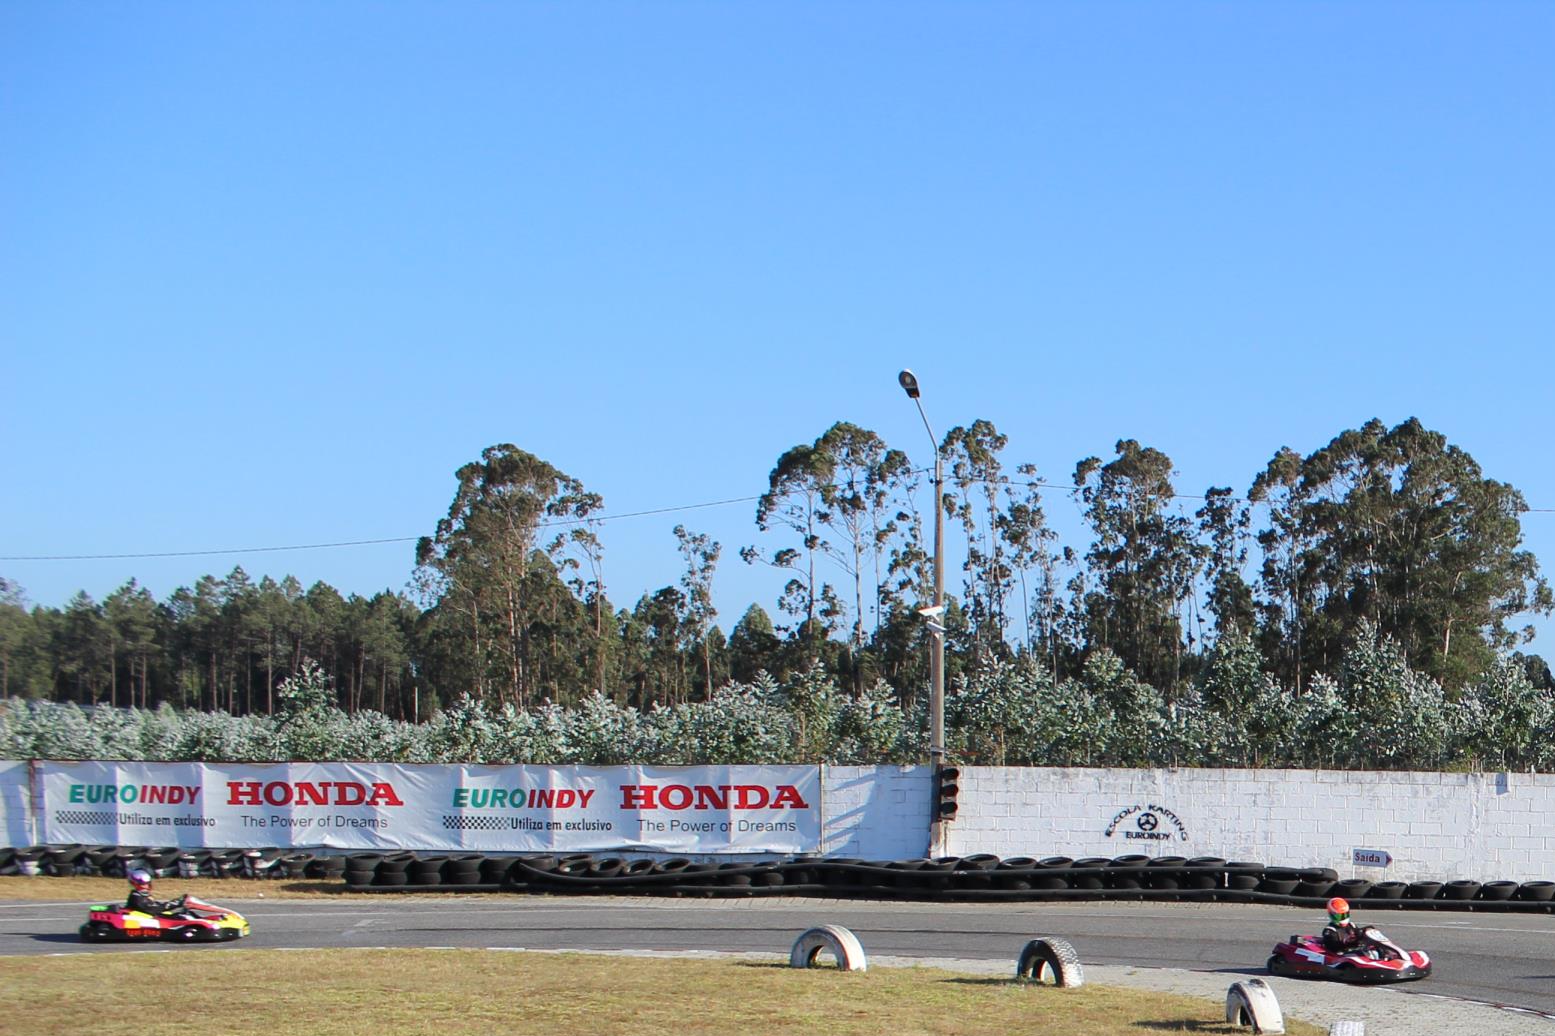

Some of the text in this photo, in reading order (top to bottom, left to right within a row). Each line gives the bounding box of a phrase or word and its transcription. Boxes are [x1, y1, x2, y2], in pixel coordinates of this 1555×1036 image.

[69, 784, 201, 804] EUROINDY
[226, 781, 404, 806] HONDA
[453, 788, 595, 809] EUROINDY
[619, 784, 809, 810] HONDA
[119, 813, 216, 827] Utiliza em exclusivo
[241, 815, 388, 828] The Power of Dreams
[511, 818, 612, 831] Utiliza em exclusivo
[636, 819, 797, 832] The Power of Dreams
[1105, 804, 1189, 841] ESCOLA KARTING
[1125, 832, 1170, 841] EUROINDY
